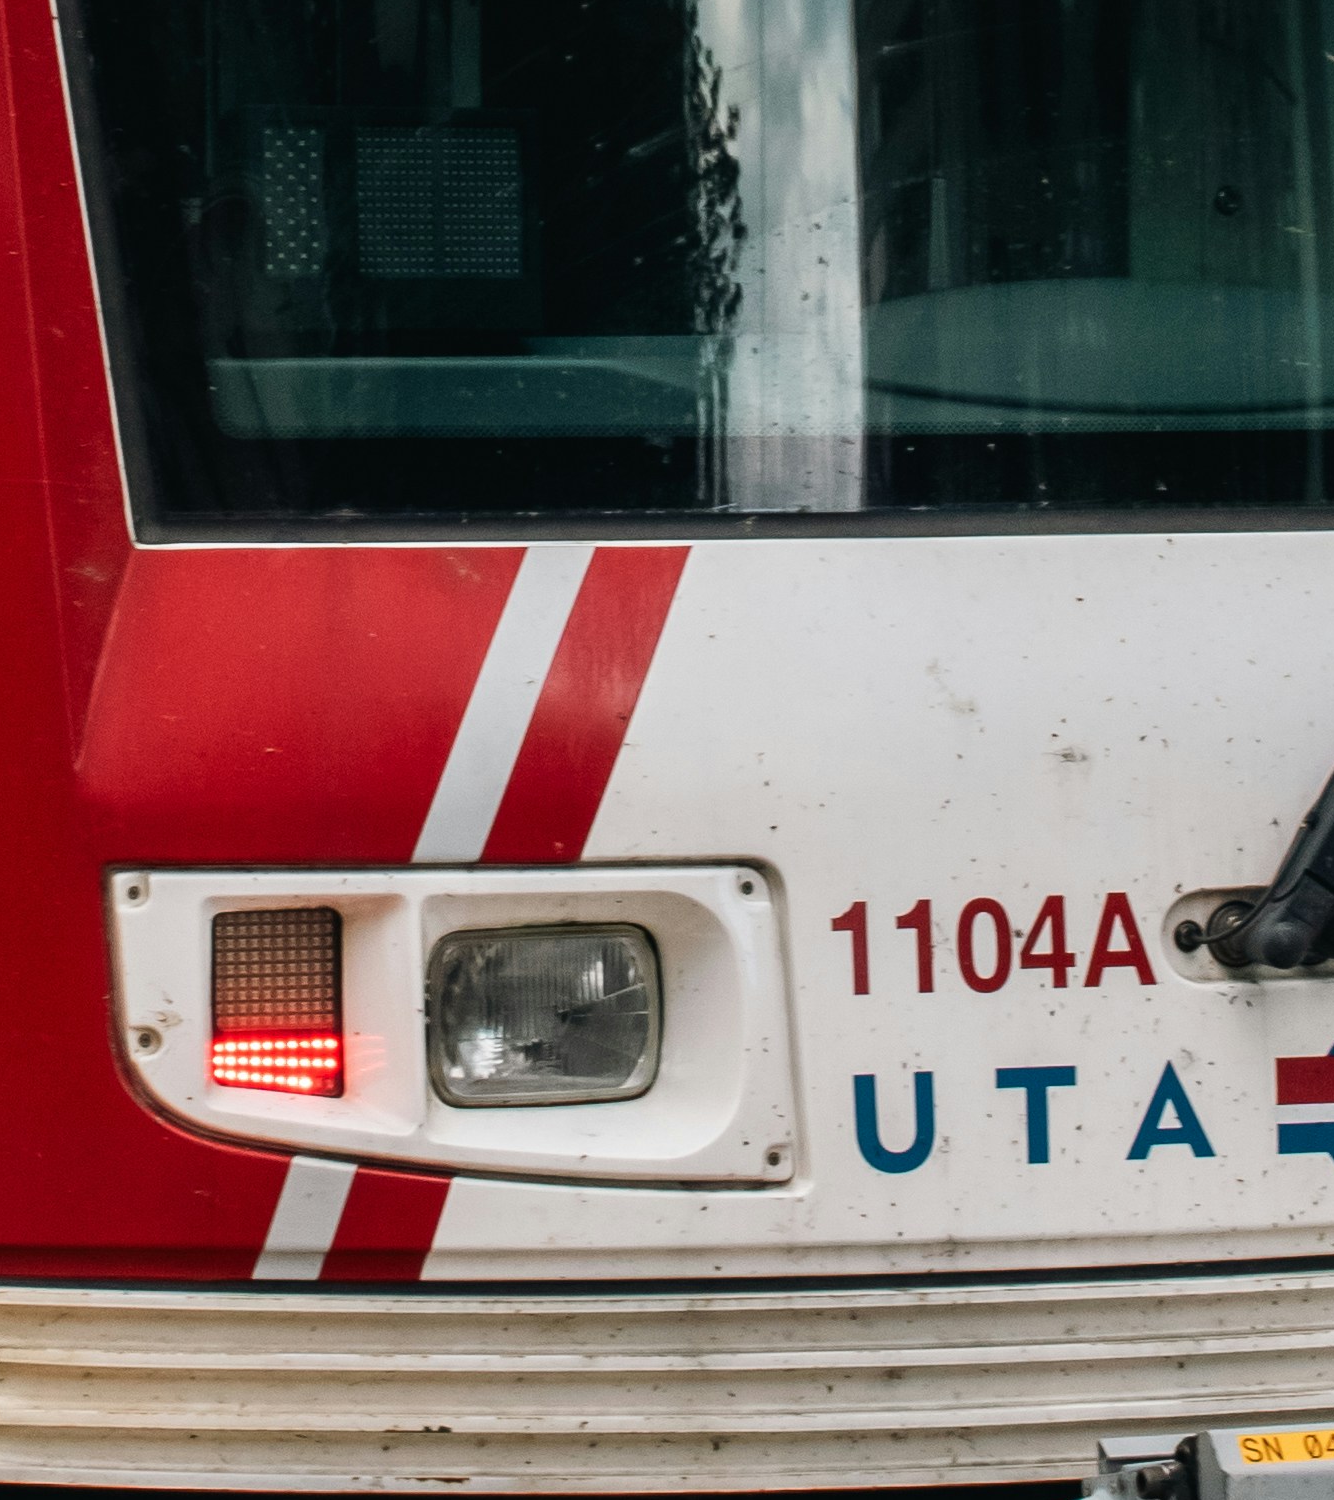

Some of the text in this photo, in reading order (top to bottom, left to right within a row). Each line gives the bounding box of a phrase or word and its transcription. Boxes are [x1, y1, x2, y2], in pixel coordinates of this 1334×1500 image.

[830, 891, 1158, 996] 1104A
[853, 1060, 1216, 1174] UTA
[1241, 1437, 1284, 1462] SN
